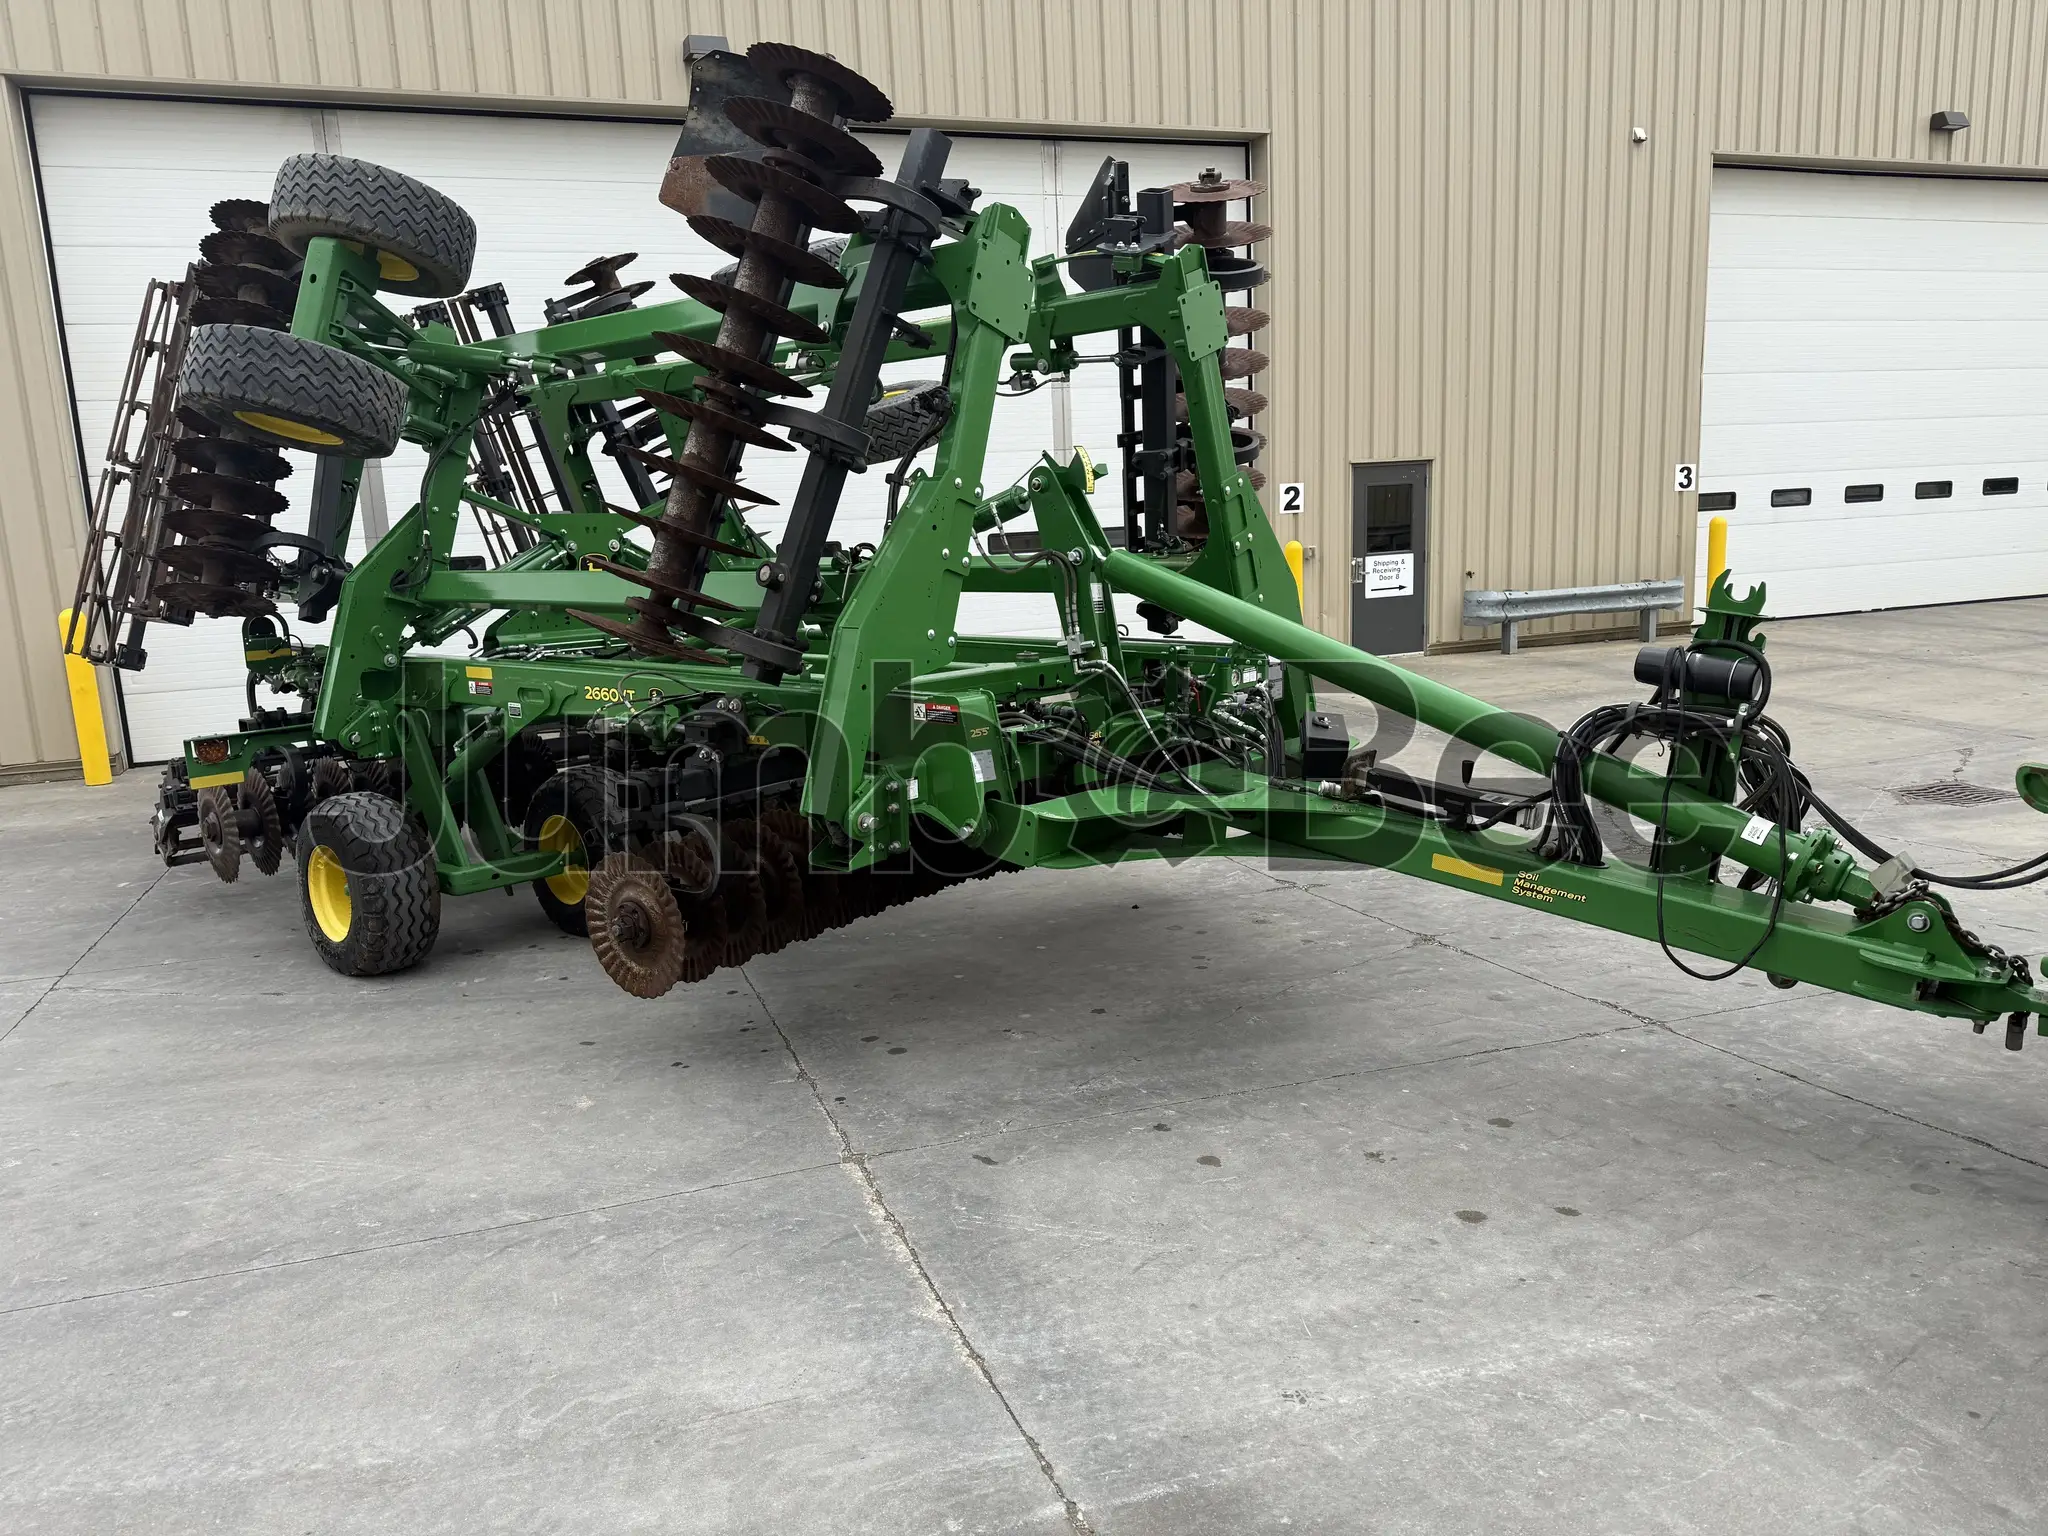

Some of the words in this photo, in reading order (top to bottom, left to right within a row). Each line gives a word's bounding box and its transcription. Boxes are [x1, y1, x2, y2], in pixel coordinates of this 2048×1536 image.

[1678, 466, 1692, 489] 3
[1283, 485, 1300, 511] 2
[1373, 559, 1399, 567] Shipping
[1517, 870, 1540, 882] Soil
[1511, 885, 1554, 903] System
[1513, 877, 1587, 903] Management
